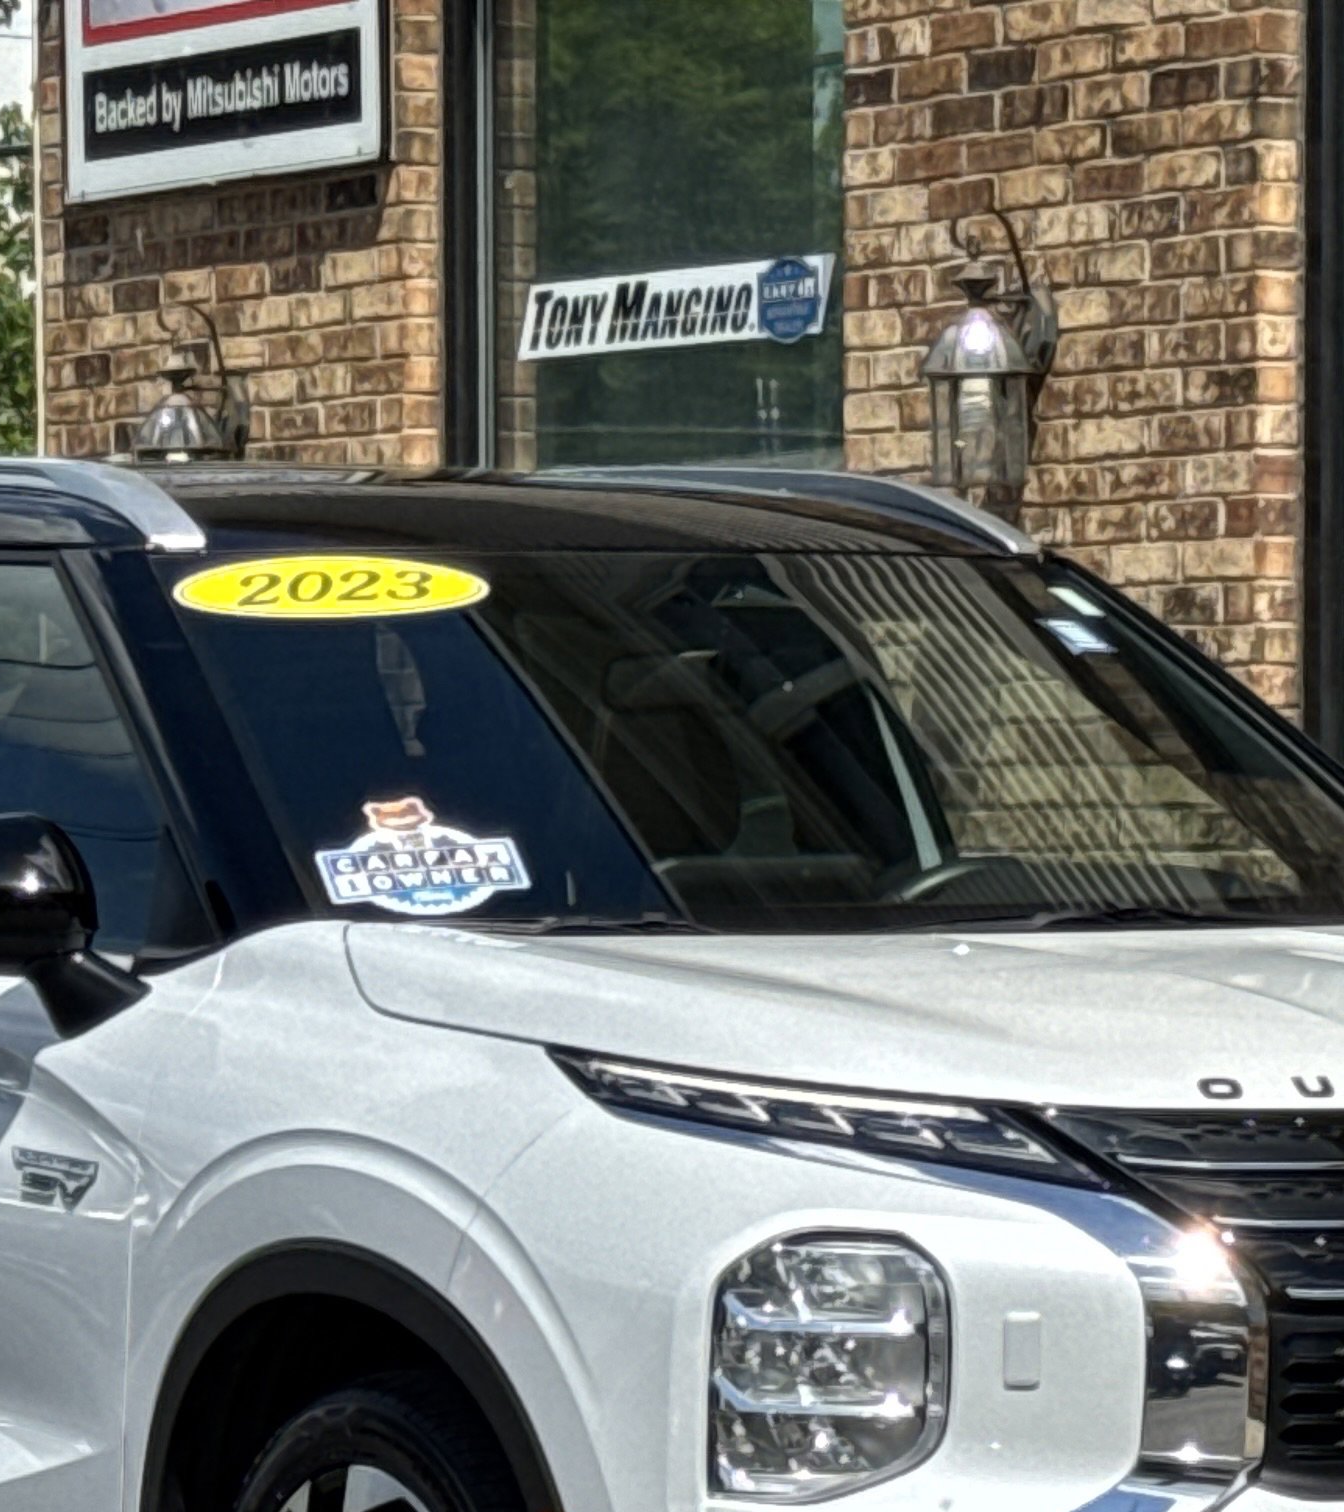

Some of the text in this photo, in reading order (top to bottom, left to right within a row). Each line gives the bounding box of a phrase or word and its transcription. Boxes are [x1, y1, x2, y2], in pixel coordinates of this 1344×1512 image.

[94, 59, 350, 133] Backed by Mitsubishi Motors
[529, 289, 609, 350] TONY
[237, 570, 434, 607] 2023
[332, 844, 514, 874] CARFAX
[370, 867, 512, 892] OWNER
